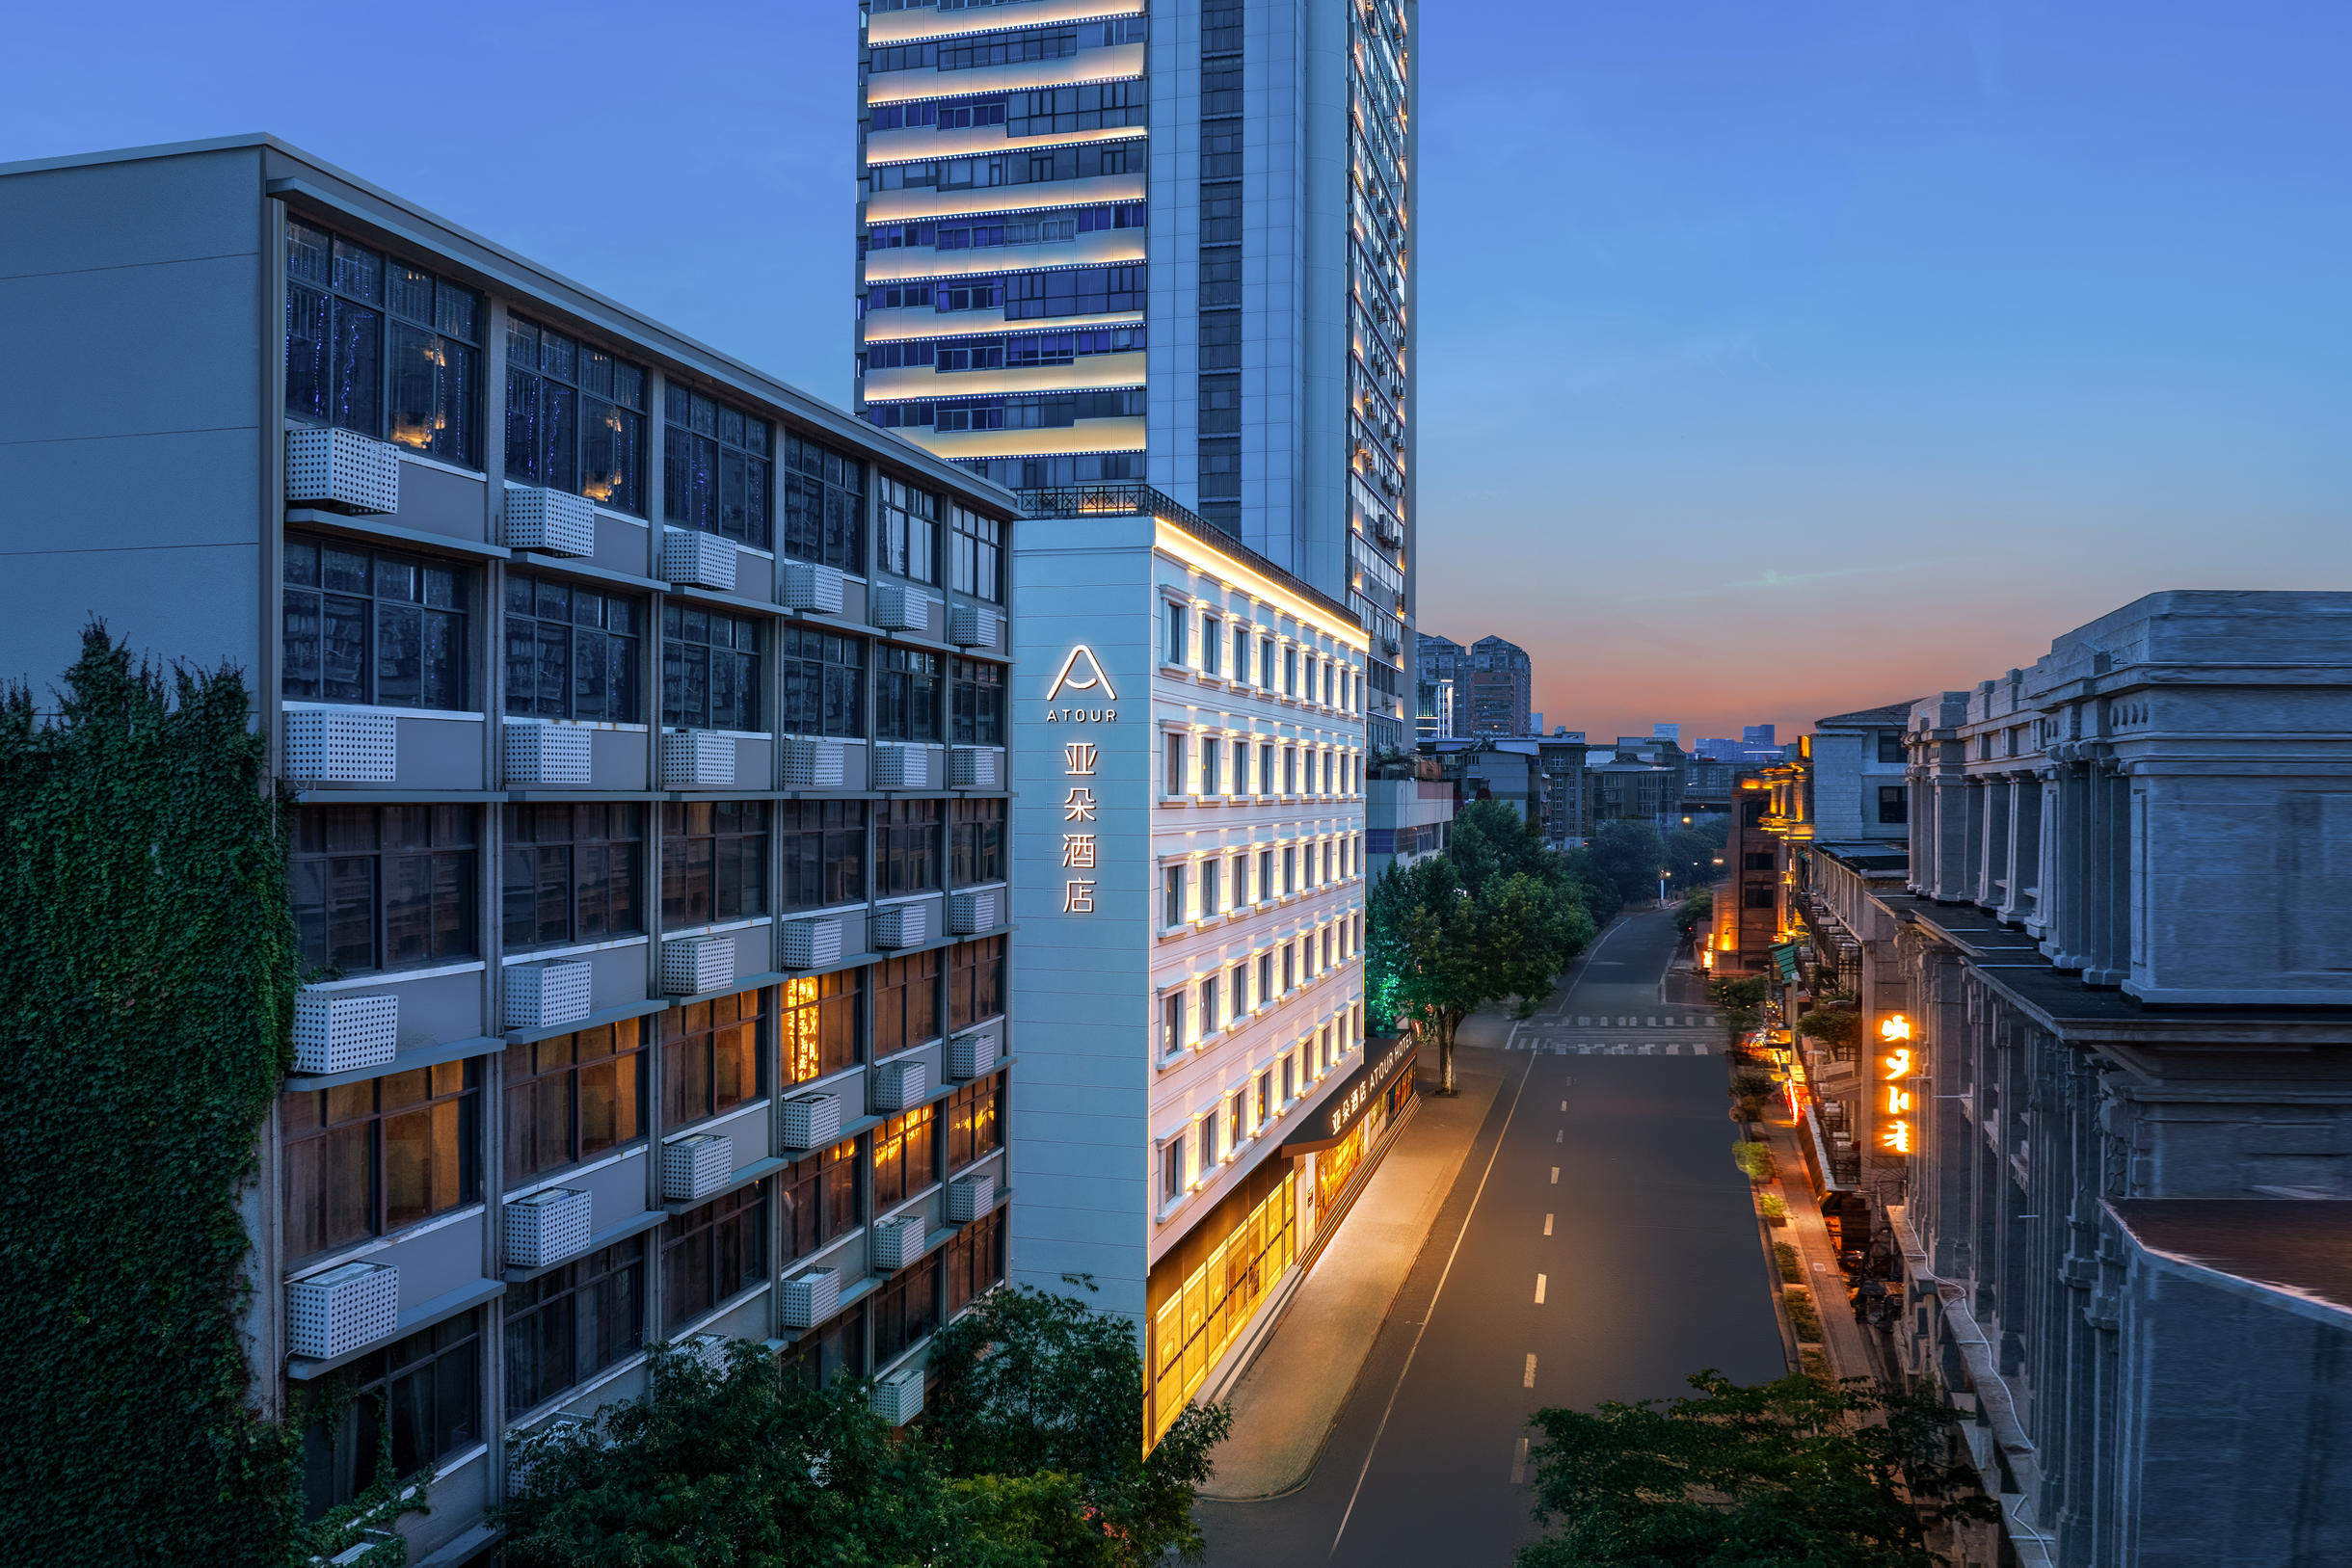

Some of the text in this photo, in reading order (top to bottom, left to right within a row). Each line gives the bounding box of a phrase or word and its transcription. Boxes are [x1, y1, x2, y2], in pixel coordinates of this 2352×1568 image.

[1046, 708, 1118, 723] ATOUR
[1062, 742, 1098, 914] 亚朵酒店
[1331, 1031, 1413, 1136] 亚朵酒店 ATOUR HOTEL
